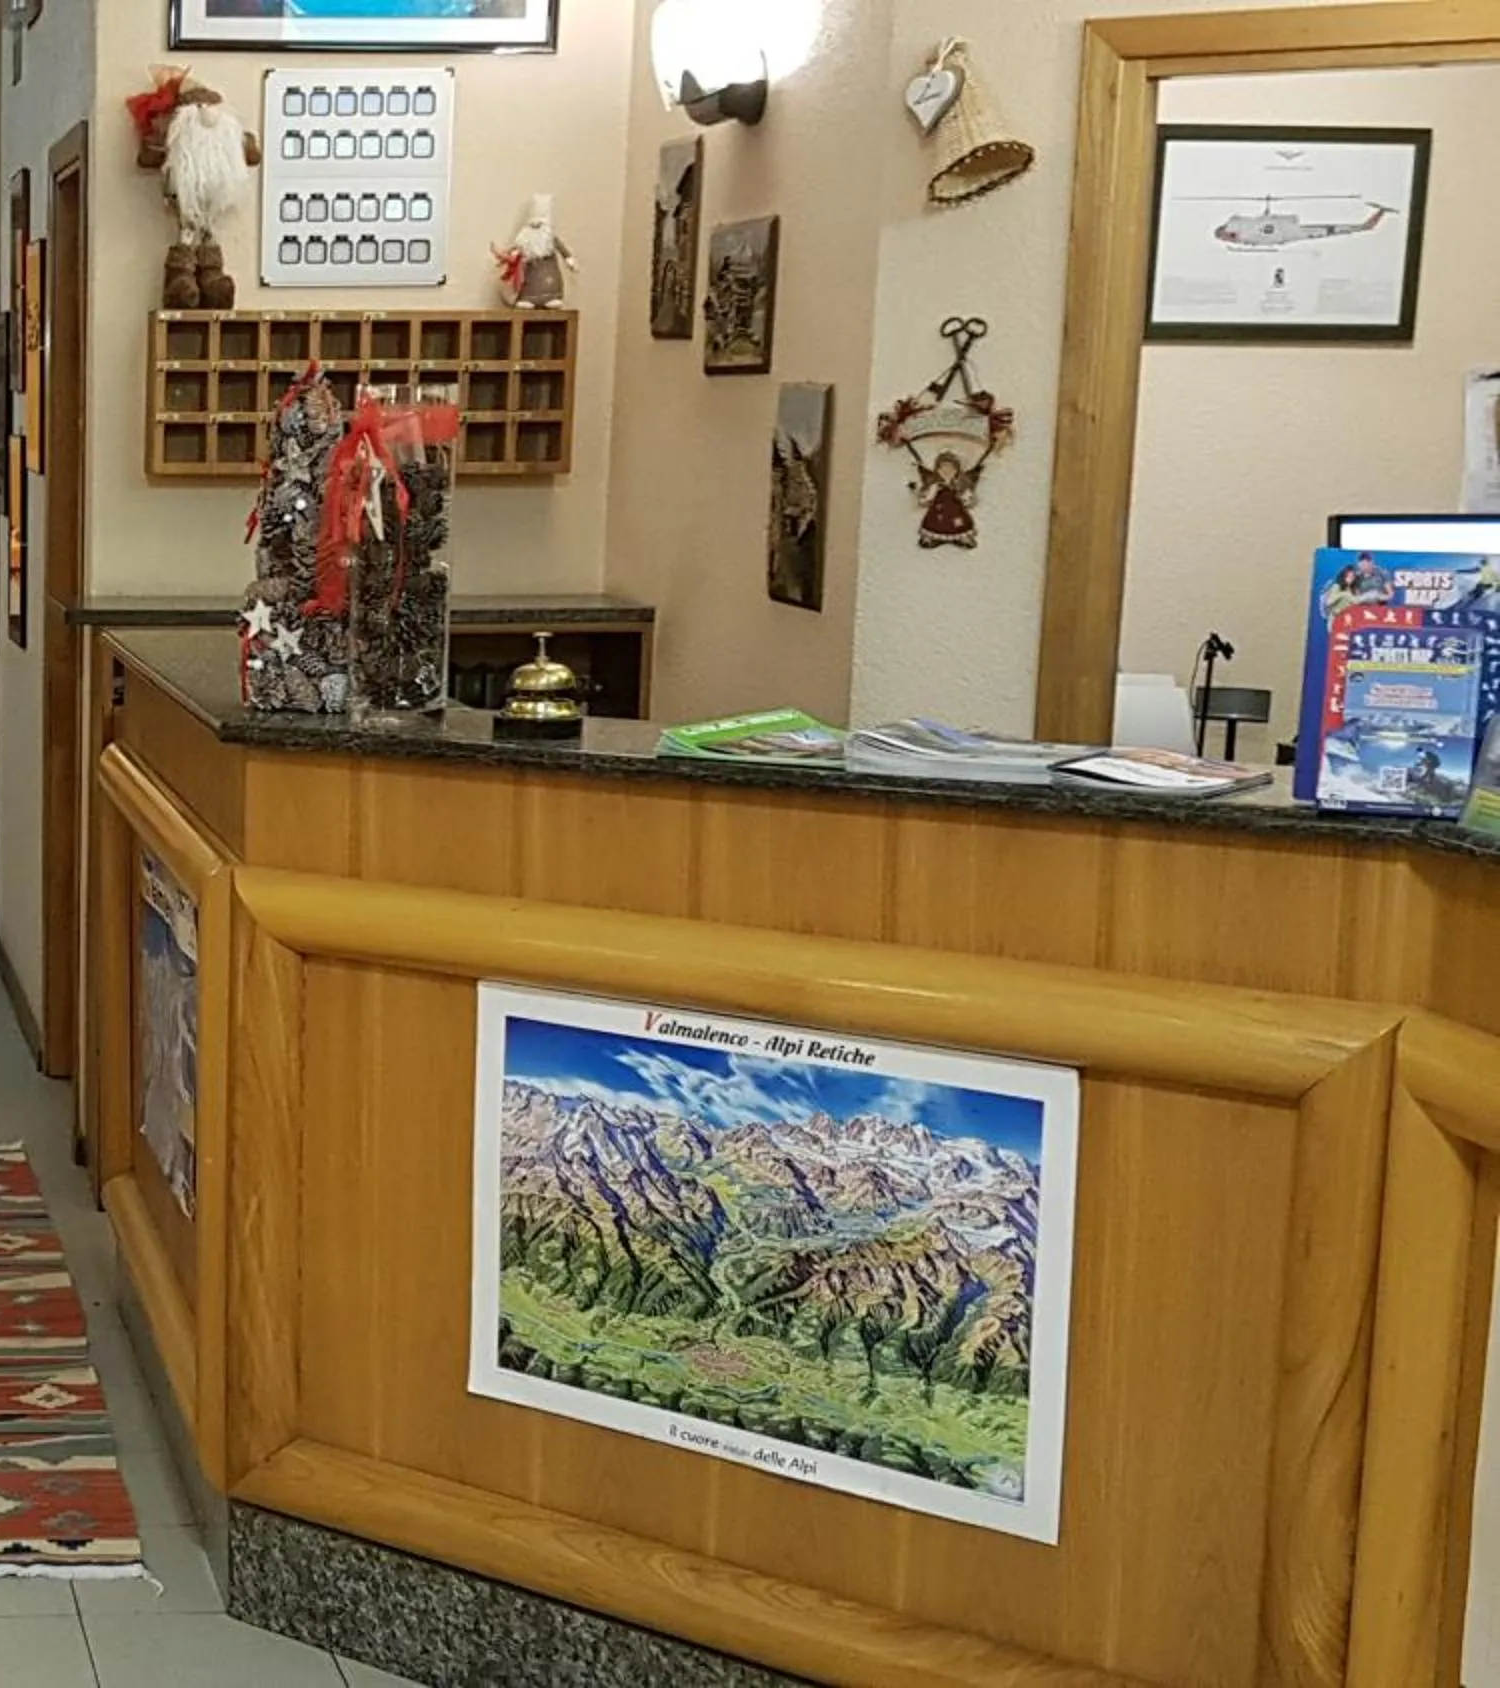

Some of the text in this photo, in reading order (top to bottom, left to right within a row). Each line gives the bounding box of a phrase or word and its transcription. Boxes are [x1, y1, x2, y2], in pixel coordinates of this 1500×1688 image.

[1394, 570, 1455, 589] SPORTS
[644, 1011, 749, 1046] Valmalenco
[764, 1035, 804, 1057] Alpi
[807, 1040, 876, 1066] Retiche
[680, 1430, 719, 1449] cuore
[754, 1448, 786, 1468] delle
[788, 1457, 817, 1475] Alpi
